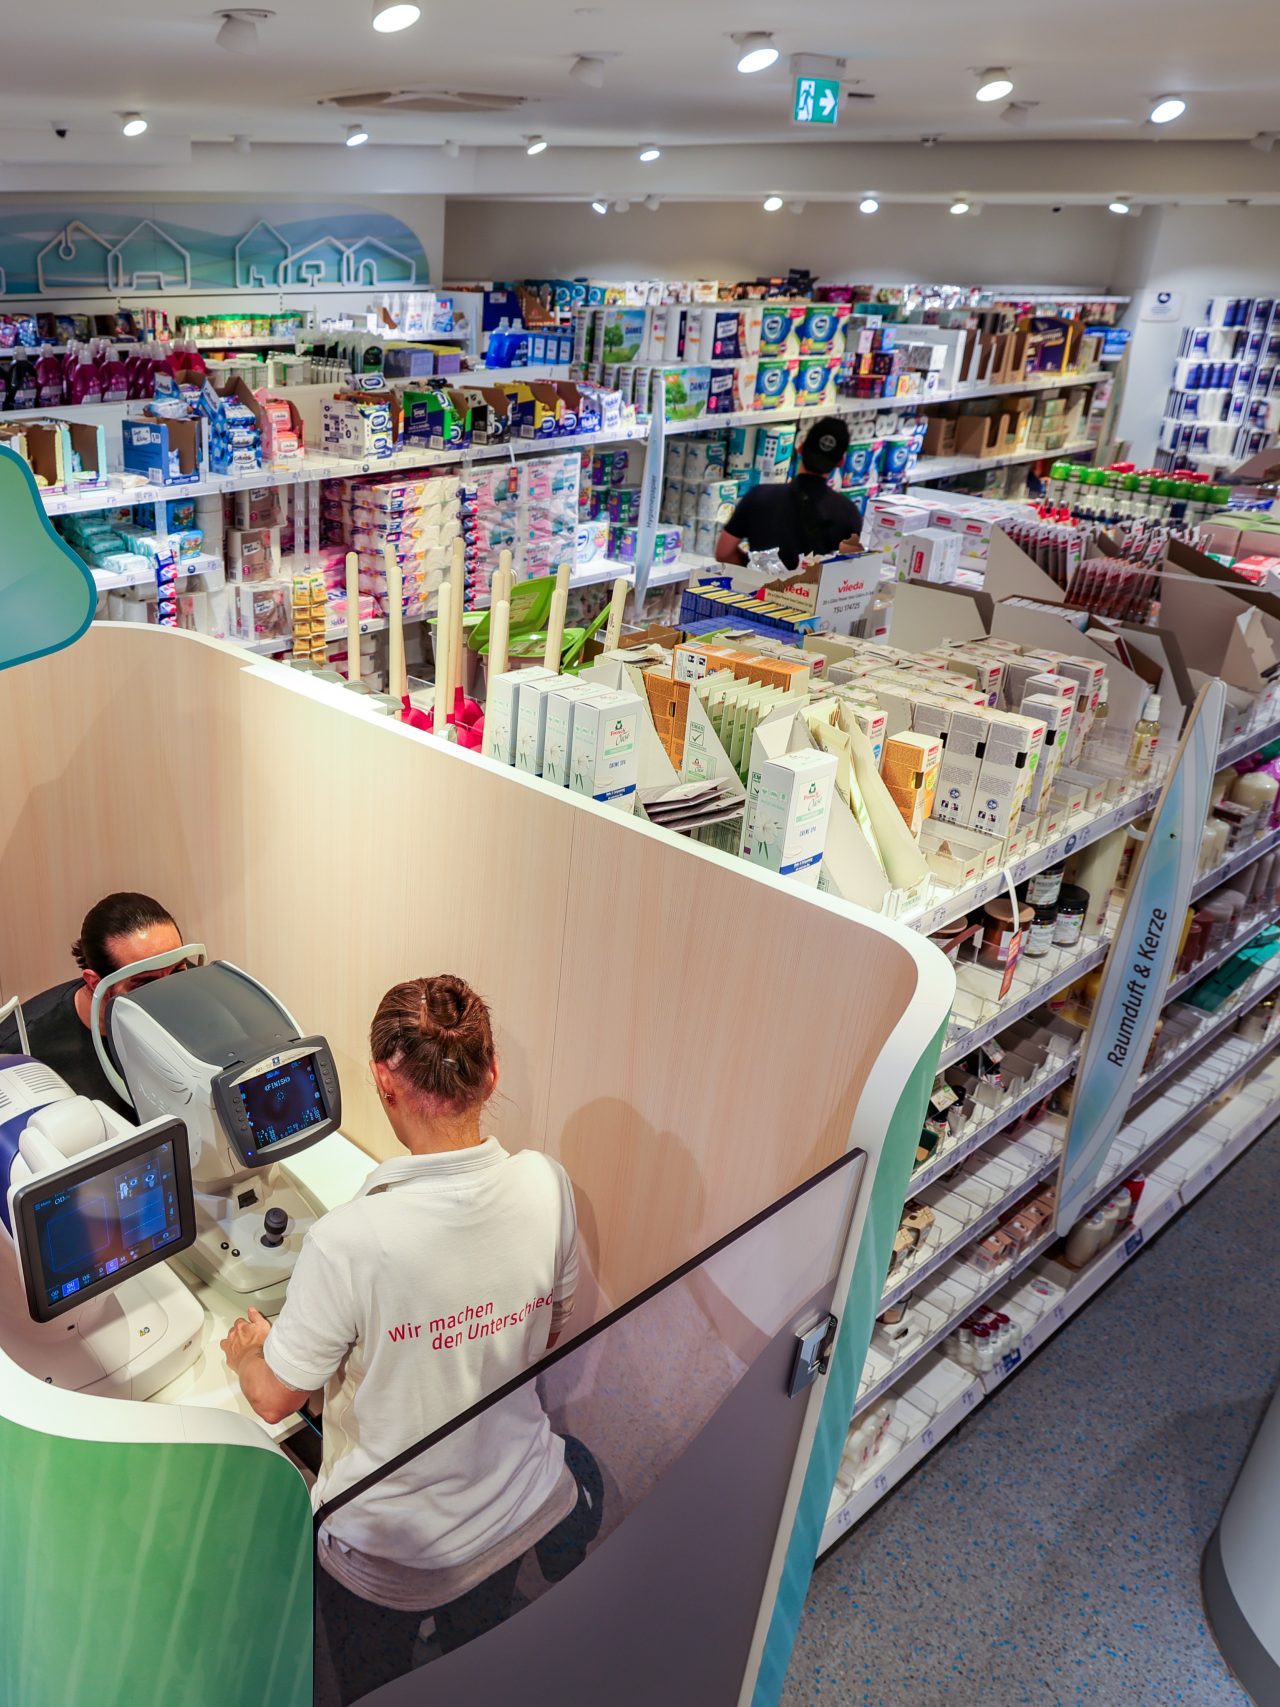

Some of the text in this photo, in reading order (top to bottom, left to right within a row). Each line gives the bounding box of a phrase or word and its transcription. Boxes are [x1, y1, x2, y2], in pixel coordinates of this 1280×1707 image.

[837, 581, 864, 593] vileda
[1107, 908, 1167, 1068] Raumduft & Kerze
[388, 1301, 494, 1343] Wir machen
[432, 1331, 463, 1350] den
